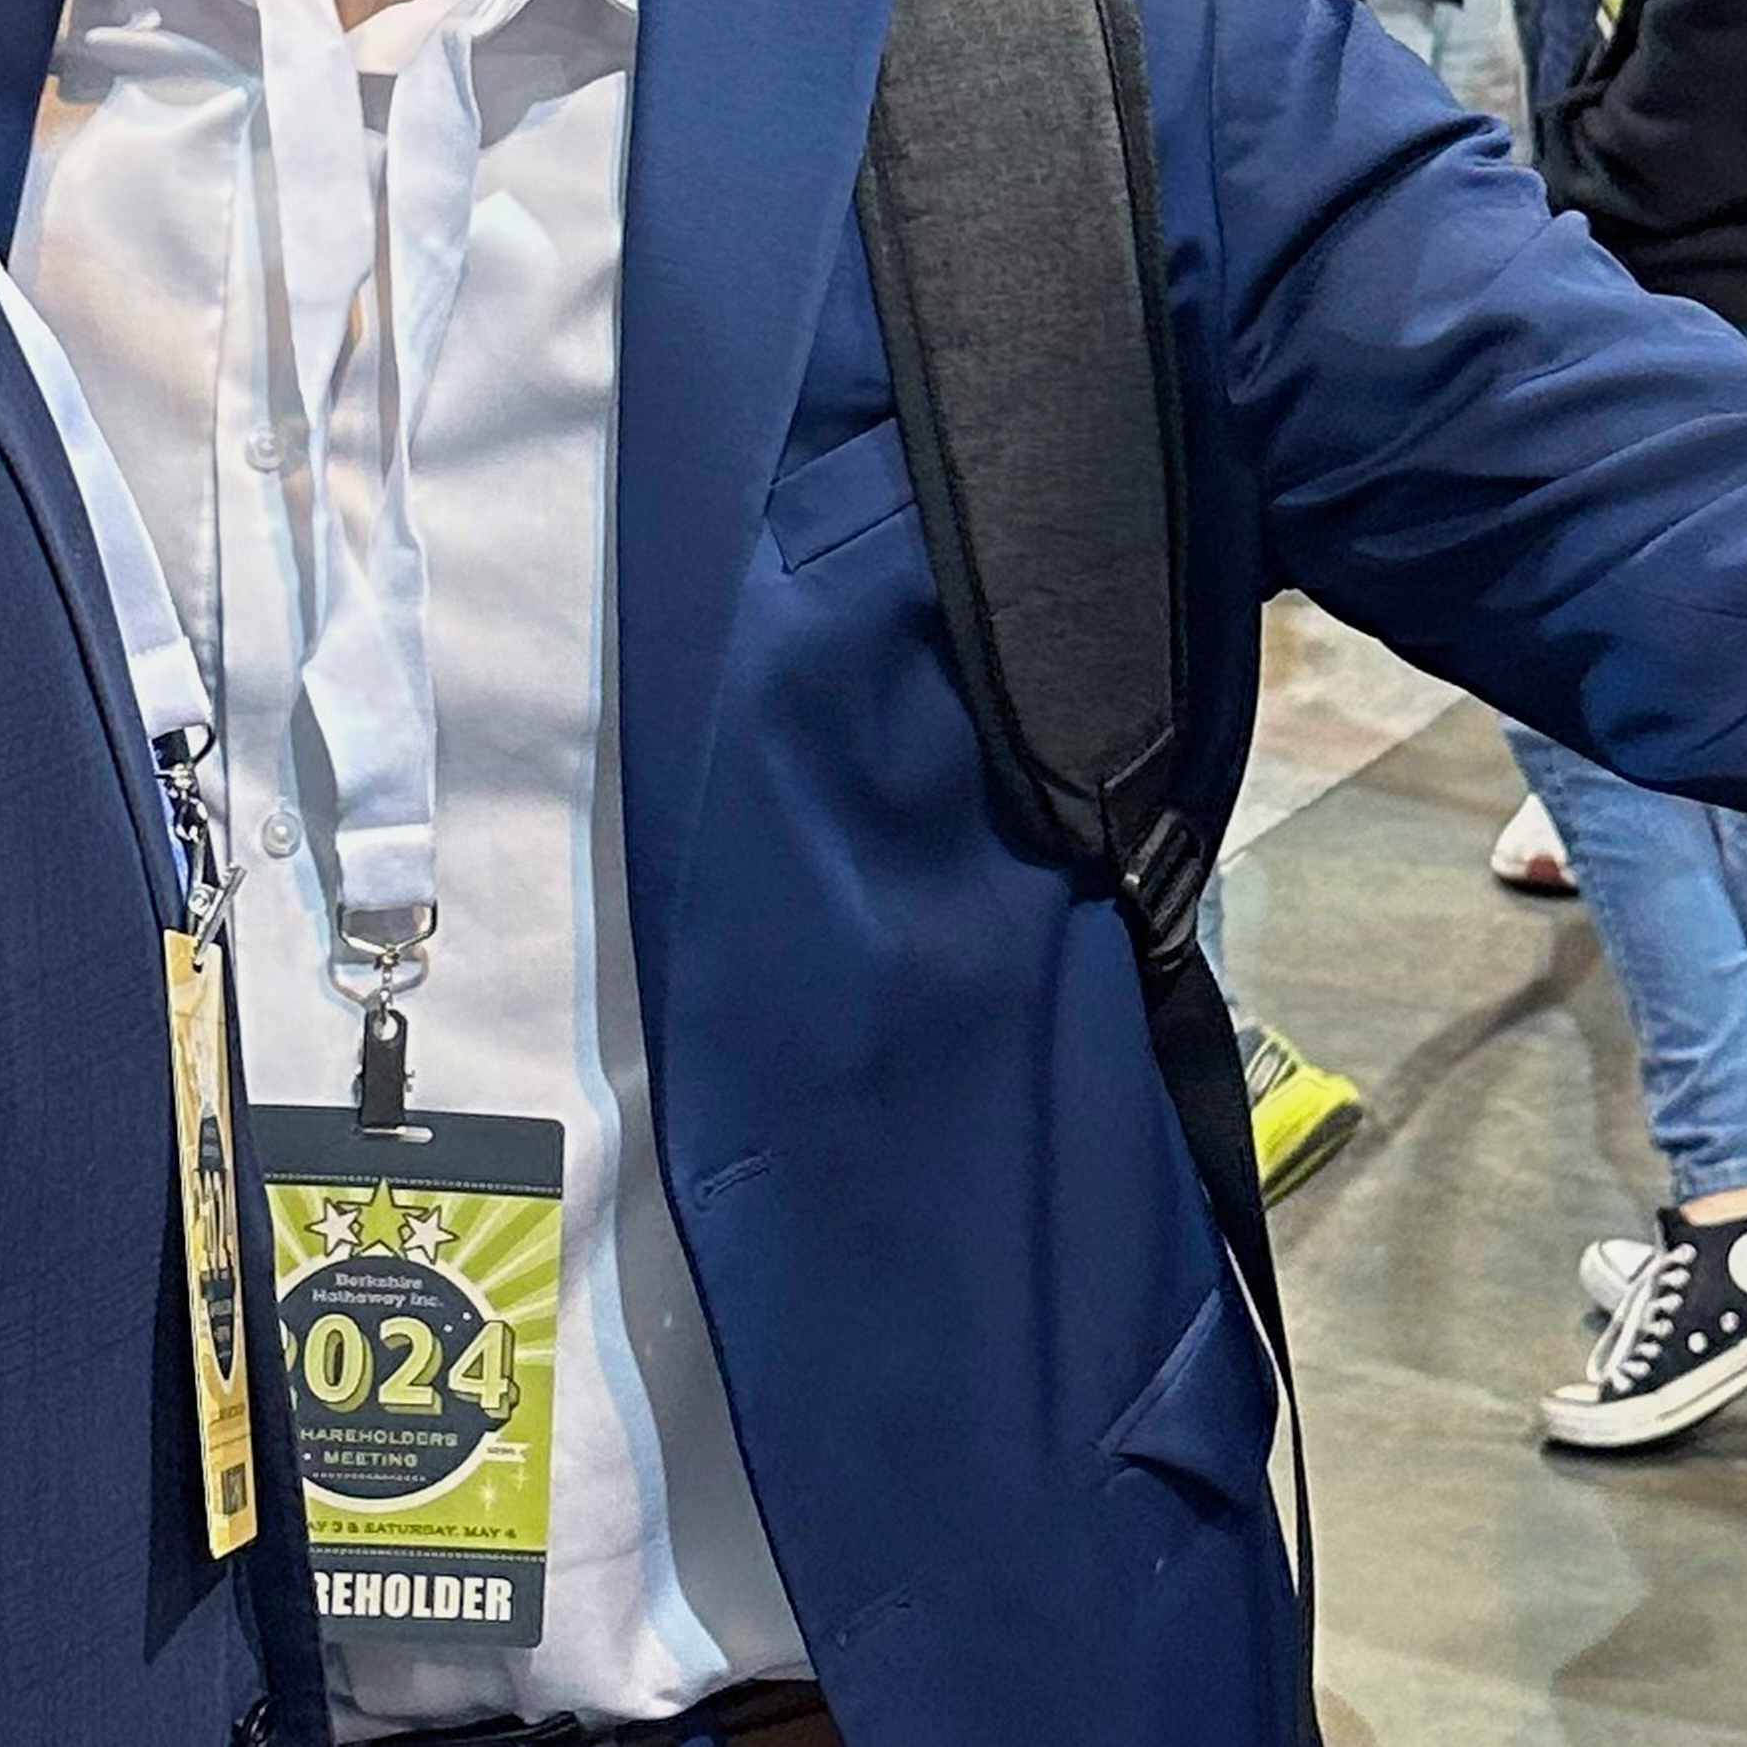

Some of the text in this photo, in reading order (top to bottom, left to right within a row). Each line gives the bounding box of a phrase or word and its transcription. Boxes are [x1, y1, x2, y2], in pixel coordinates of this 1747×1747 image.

[335, 1272, 424, 1290] Berkshire
[312, 1288, 406, 1309] Hathaway
[279, 1312, 520, 1420] 024
[323, 1449, 419, 1469] MEETING
